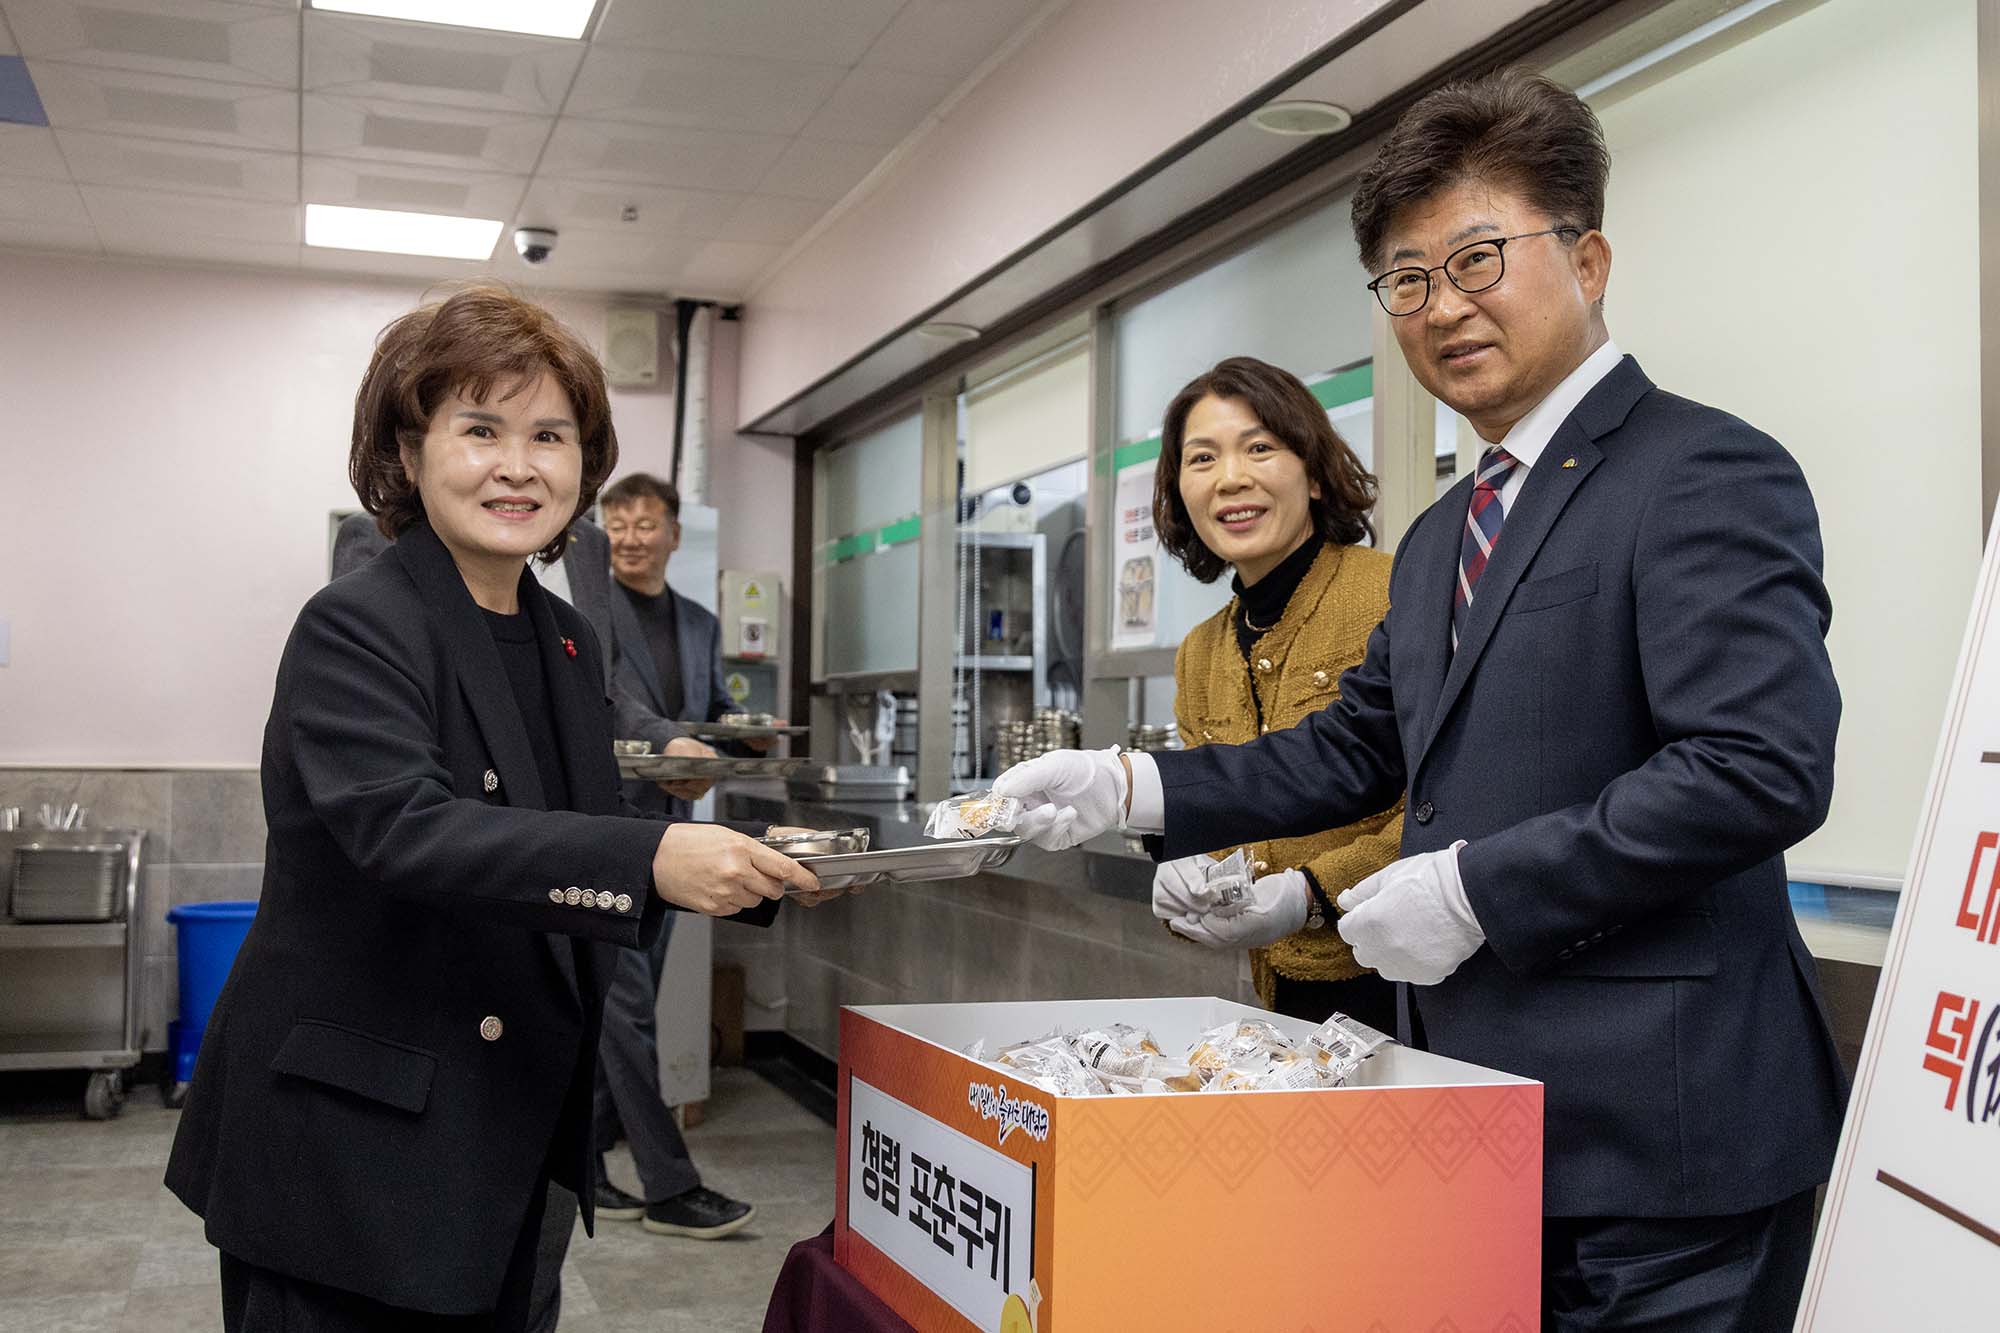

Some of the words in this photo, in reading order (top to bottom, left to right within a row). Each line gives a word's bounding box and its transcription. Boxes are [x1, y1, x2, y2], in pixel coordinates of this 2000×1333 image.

[980, 1086, 998, 1116] 일상이
[998, 1087, 1019, 1141] 즐거운
[1021, 1104, 1048, 1137] 대덕구
[862, 1120, 901, 1217] 청렴
[909, 1151, 1011, 1295] 포춘쿠키
